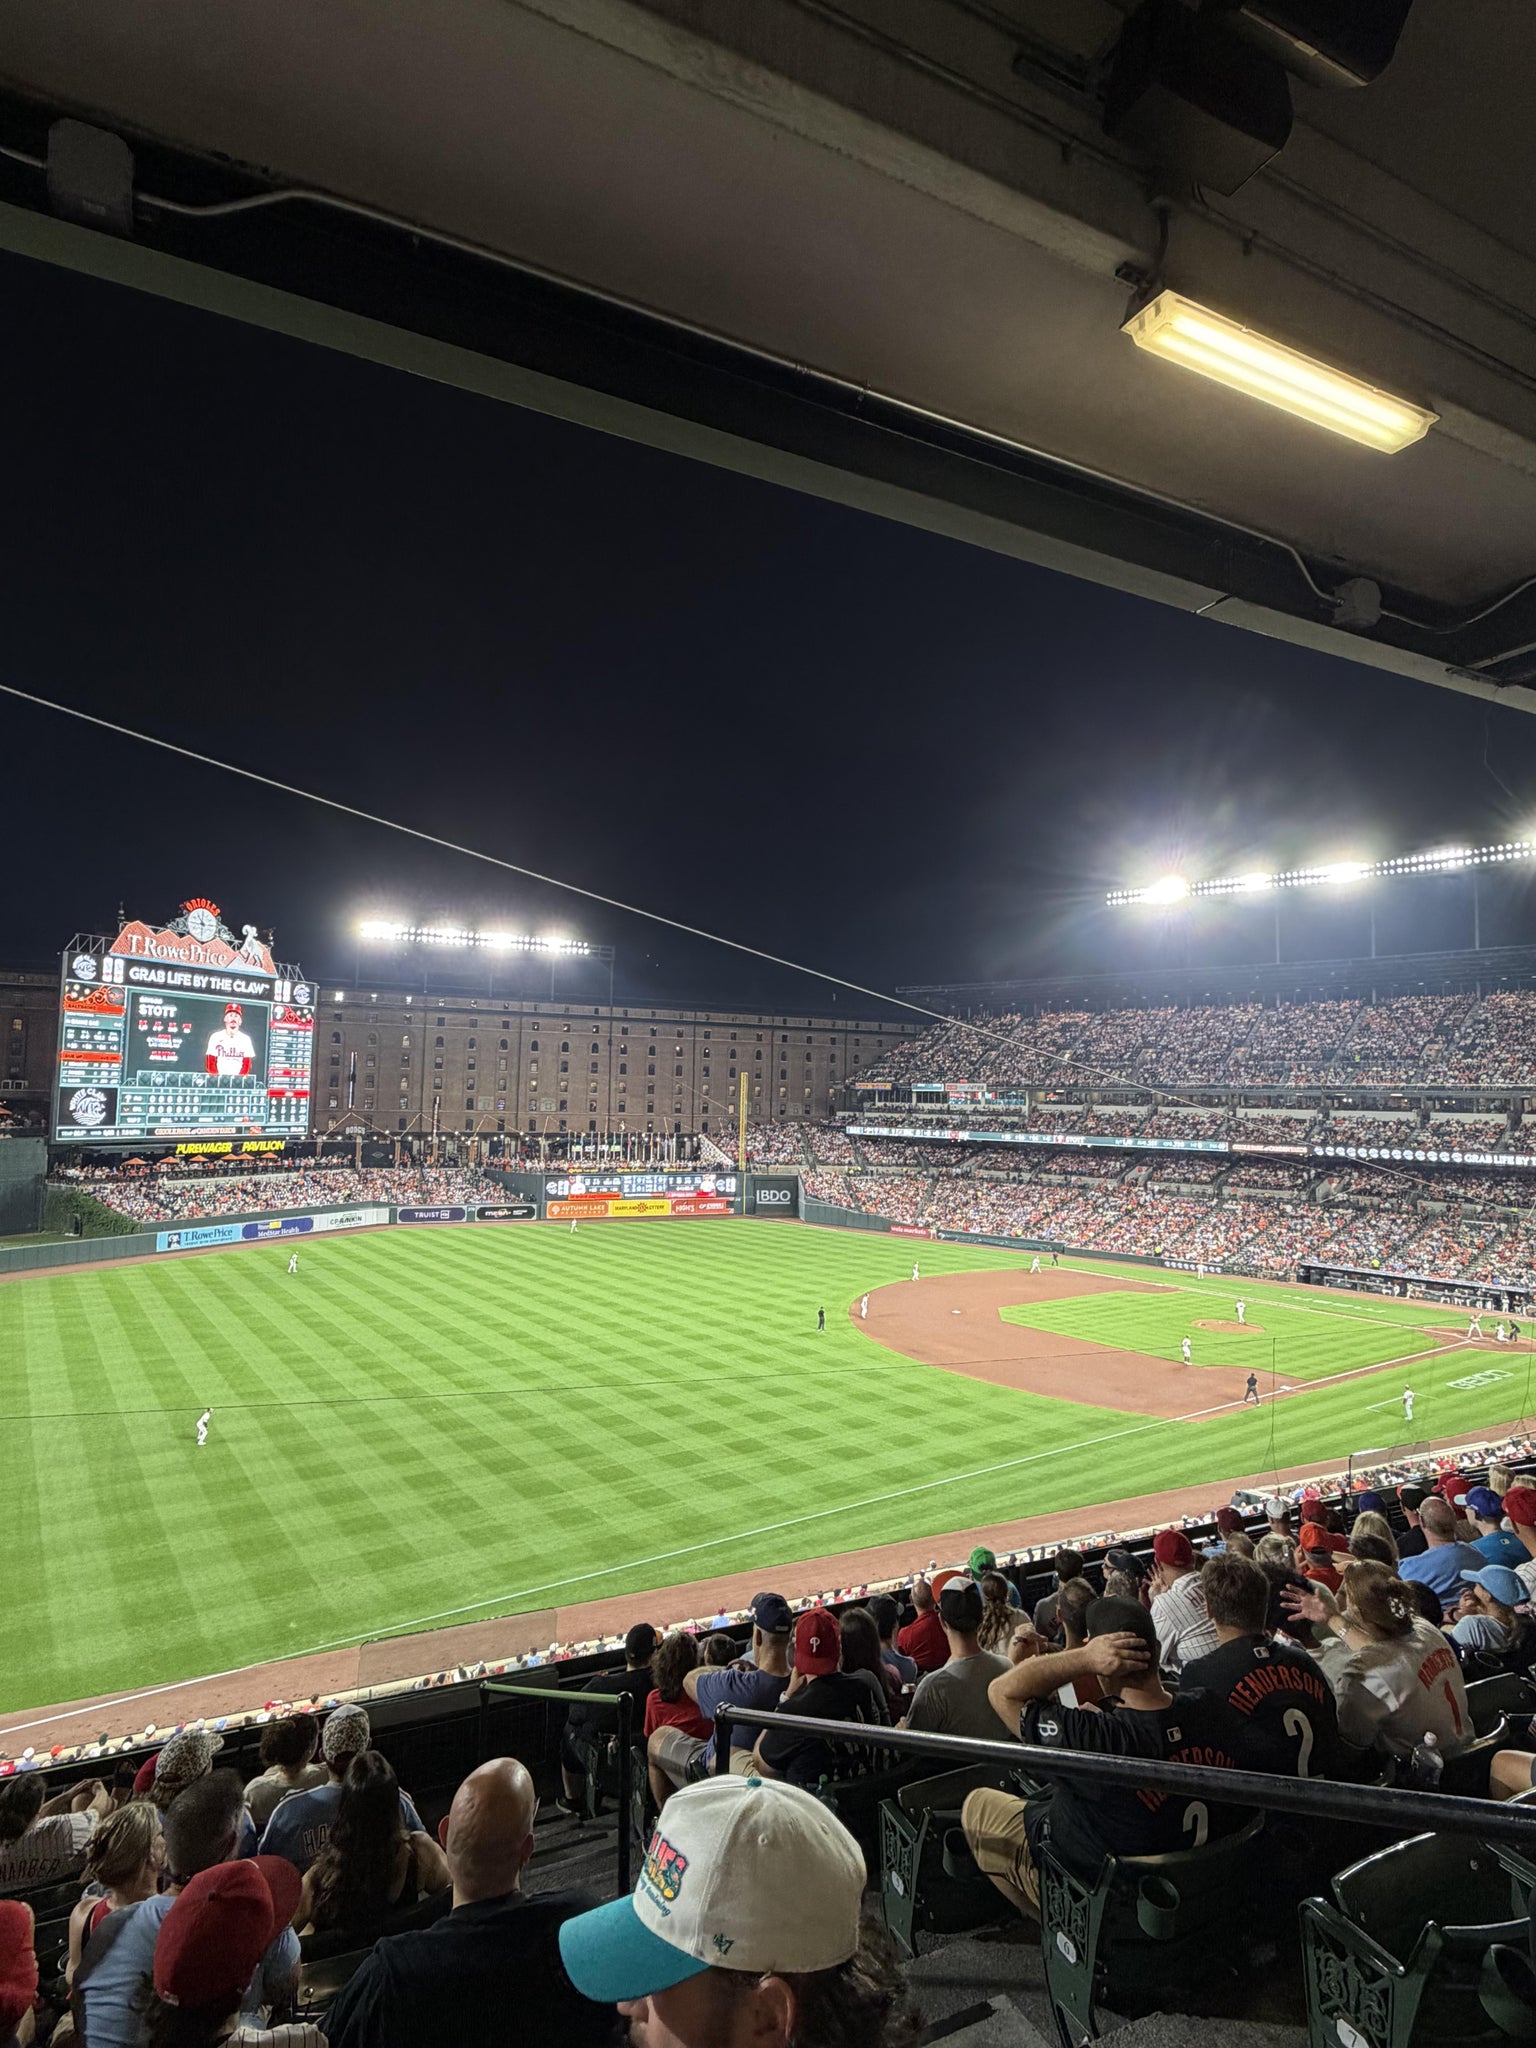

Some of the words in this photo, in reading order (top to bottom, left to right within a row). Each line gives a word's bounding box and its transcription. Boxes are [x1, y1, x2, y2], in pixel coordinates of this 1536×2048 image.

[186, 898, 220, 917] ORIOLES
[189, 944, 227, 966] Price
[129, 967, 165, 984] GRAB
[167, 971, 192, 985] LIFE
[193, 973, 208, 988] BY
[209, 976, 232, 992] THE
[139, 1004, 177, 1018] STOTT
[176, 1142, 233, 1154] PUREWAGER
[242, 1140, 286, 1152] PAVILION
[1464, 1153, 1493, 1164] GRAB
[1493, 1154, 1515, 1165] LIFE
[1515, 1156, 1530, 1166] BY
[760, 1190, 791, 1201] BDO
[414, 1211, 439, 1219] TRUIST
[213, 1228, 233, 1238] Price
[257, 1229, 281, 1237] MedStar
[280, 1226, 300, 1235] Health
[1445, 1369, 1515, 1390] GEICO
[1228, 1664, 1325, 1716] HENDERSON
[1443, 1679, 1463, 1737] 1
[1282, 1707, 1325, 1781] 2
[1348, 2029, 1358, 2048] 7
